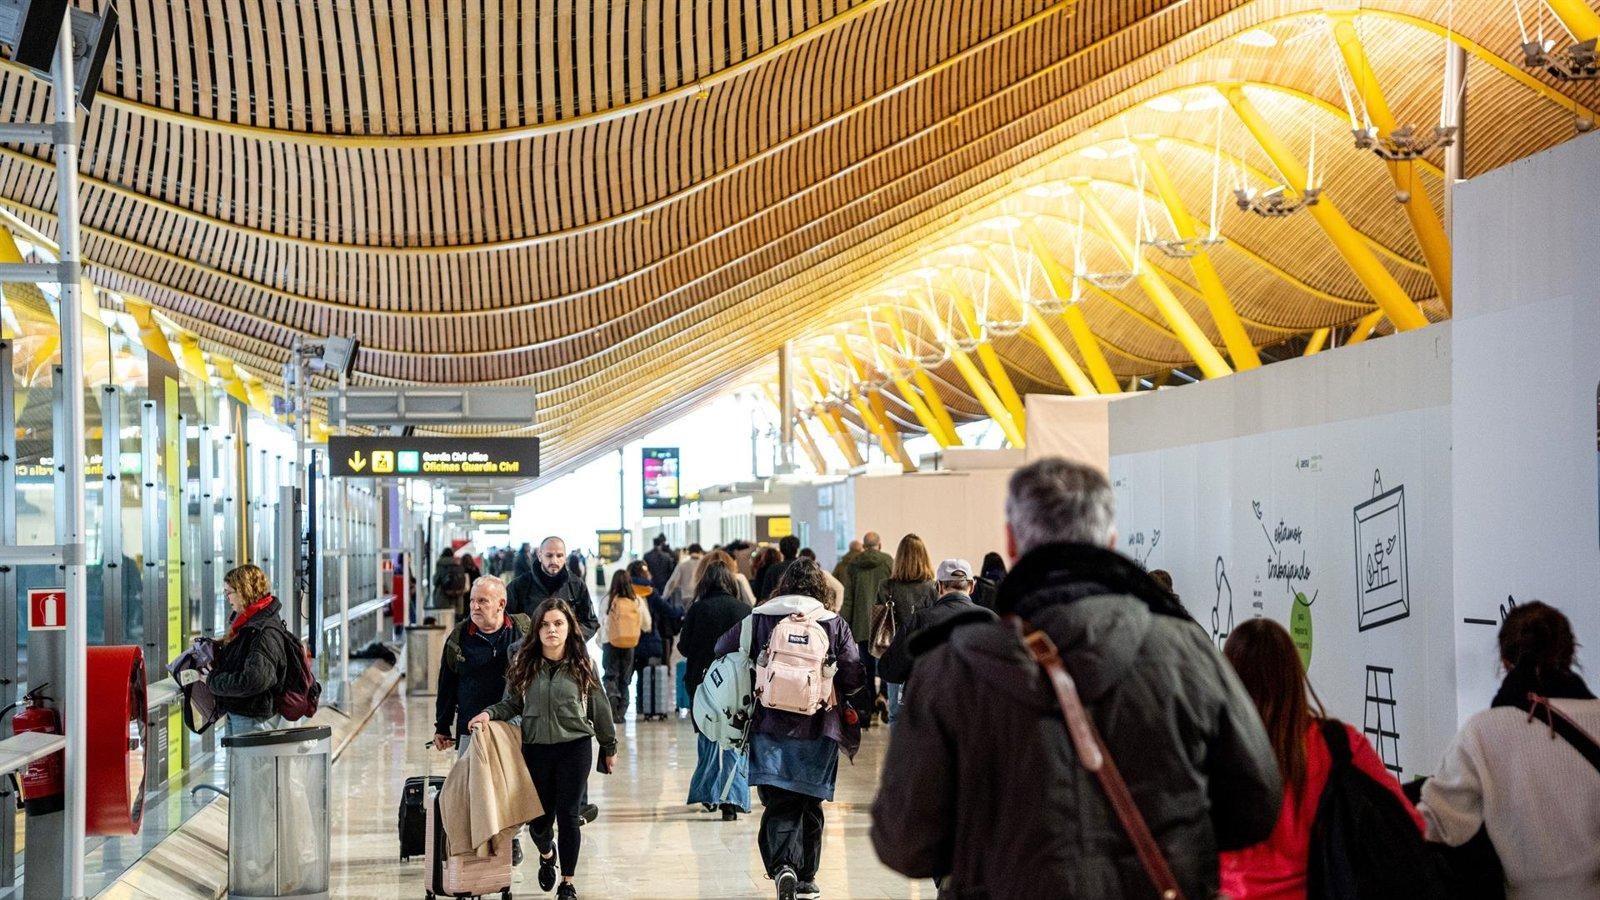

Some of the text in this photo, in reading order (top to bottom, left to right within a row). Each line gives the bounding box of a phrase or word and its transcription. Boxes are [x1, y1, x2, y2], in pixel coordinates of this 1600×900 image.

[422, 451, 489, 462] Guardia Civil office
[423, 461, 520, 473] Oficinas Guardia Civil
[1267, 549, 1312, 593] trabajando
